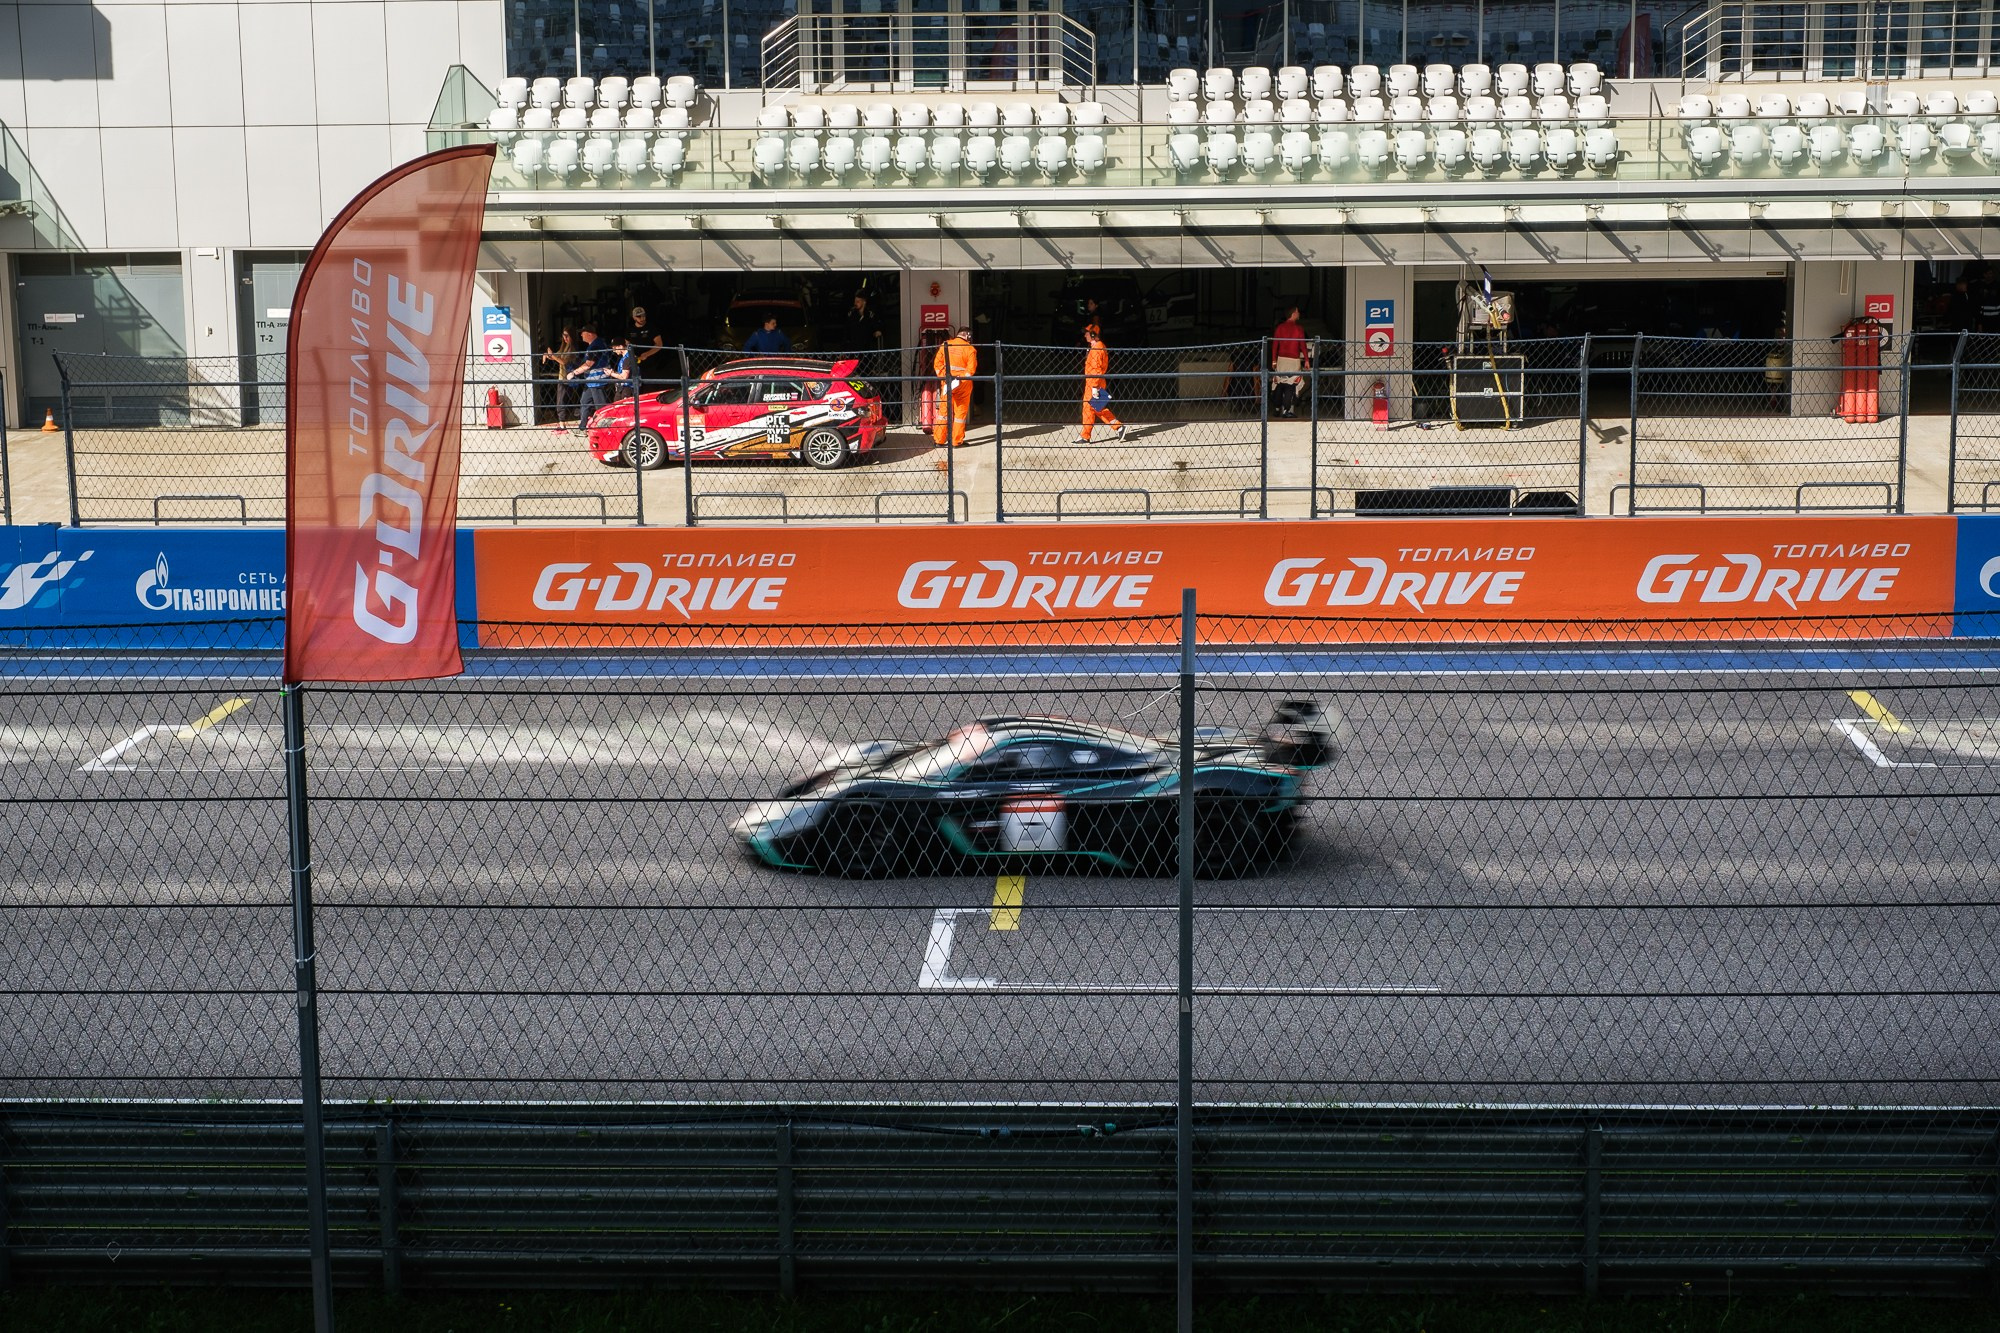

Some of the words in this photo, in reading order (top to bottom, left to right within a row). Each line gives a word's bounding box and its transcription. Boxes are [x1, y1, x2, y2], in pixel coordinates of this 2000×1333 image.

[1370, 307, 1389, 318] 21
[1868, 302, 1890, 313] 20
[486, 313, 507, 325] 23
[924, 312, 946, 323] 22
[260, 335, 273, 343] Т-2
[349, 257, 372, 456] ТОПЛИВО
[766, 415, 785, 425] РГС
[767, 434, 783, 444] НЬ
[1399, 548, 1535, 561] ТОПЛИВО
[1774, 544, 1910, 557] ТОПЛИВО
[663, 554, 795, 567] ТОПЛИВО
[1029, 551, 1163, 564] ТОПЛИВО
[238, 572, 278, 584] СЕТЬ
